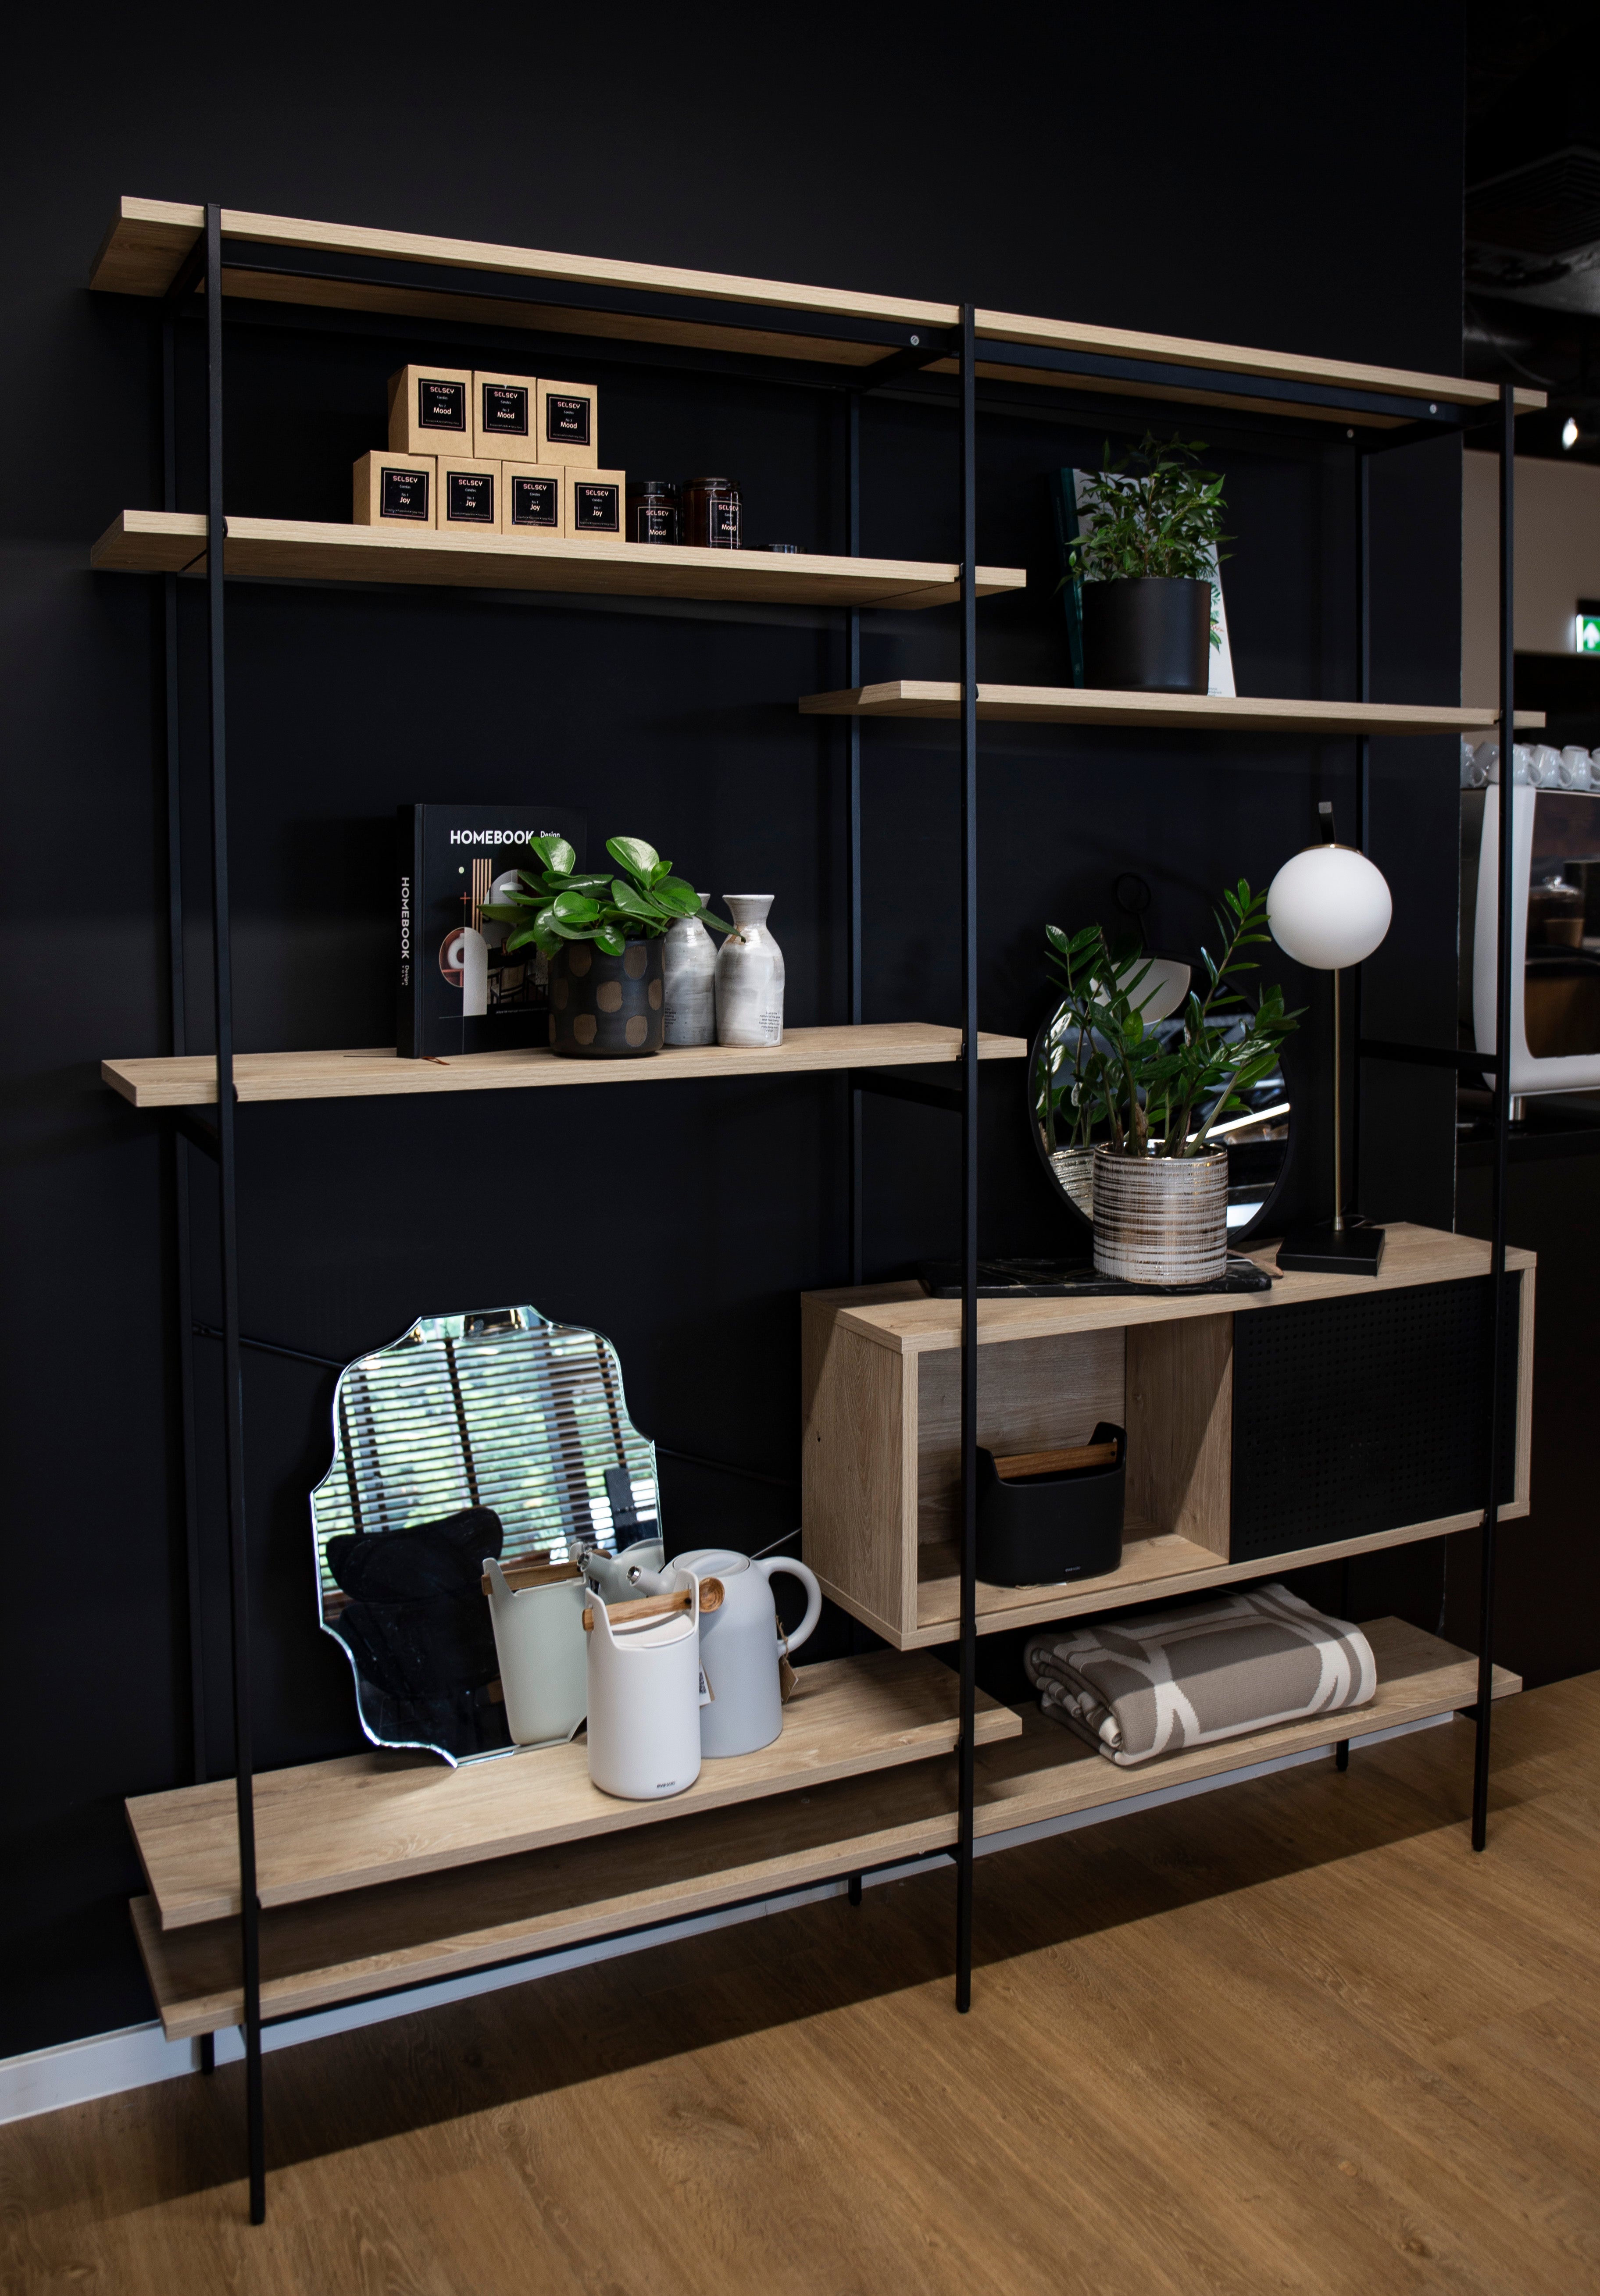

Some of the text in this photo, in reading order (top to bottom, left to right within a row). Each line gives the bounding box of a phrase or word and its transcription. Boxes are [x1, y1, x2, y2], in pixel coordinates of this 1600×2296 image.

[400, 496, 411, 505] Joy
[450, 830, 534, 845] HOMEBOOK
[401, 877, 410, 959] HOMEBOOK
